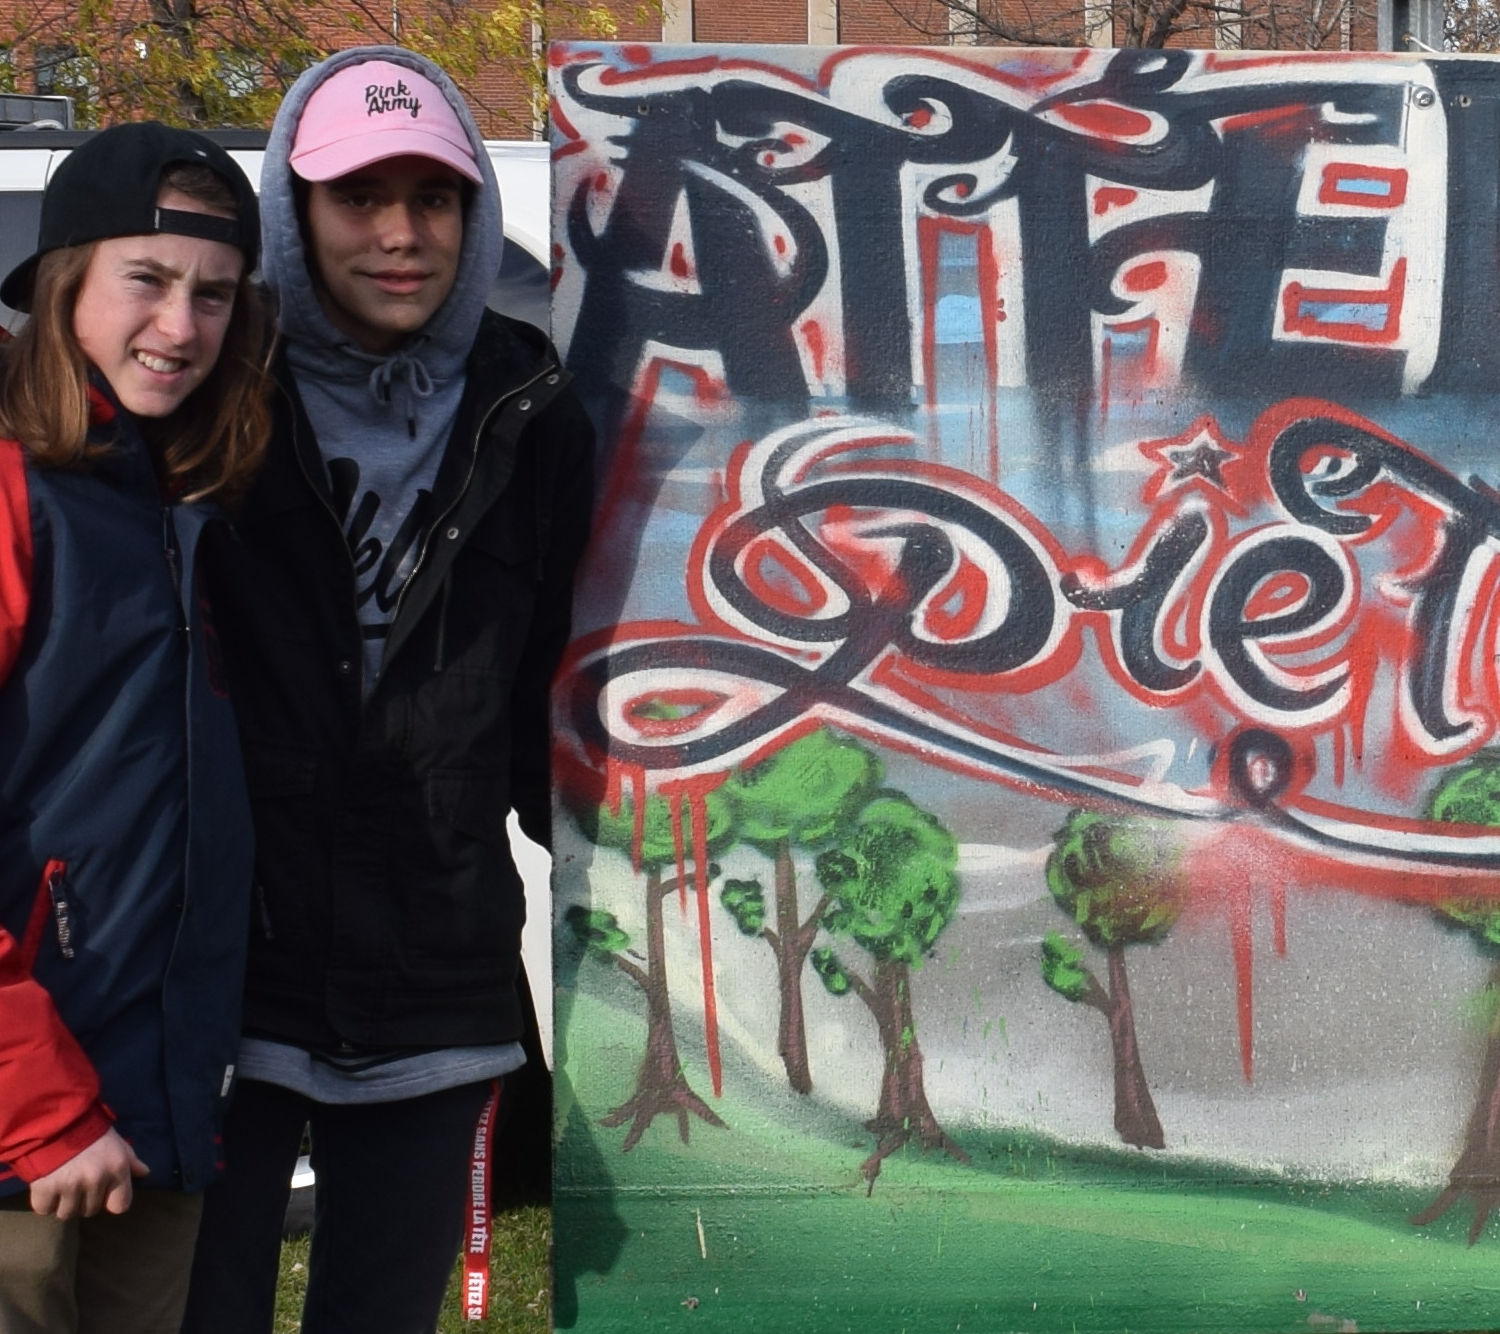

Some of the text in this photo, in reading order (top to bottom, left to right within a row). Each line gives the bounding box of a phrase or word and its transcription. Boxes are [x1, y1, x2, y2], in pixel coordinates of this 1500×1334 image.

[365, 79, 411, 103] Pink
[367, 96, 422, 118] Army
[473, 1126, 488, 1160] SANS
[471, 1161, 486, 1208] PERDRE
[472, 1209, 487, 1225] LA
[469, 1226, 489, 1254] TÊTE
[467, 1271, 486, 1306] FÊTEZ
